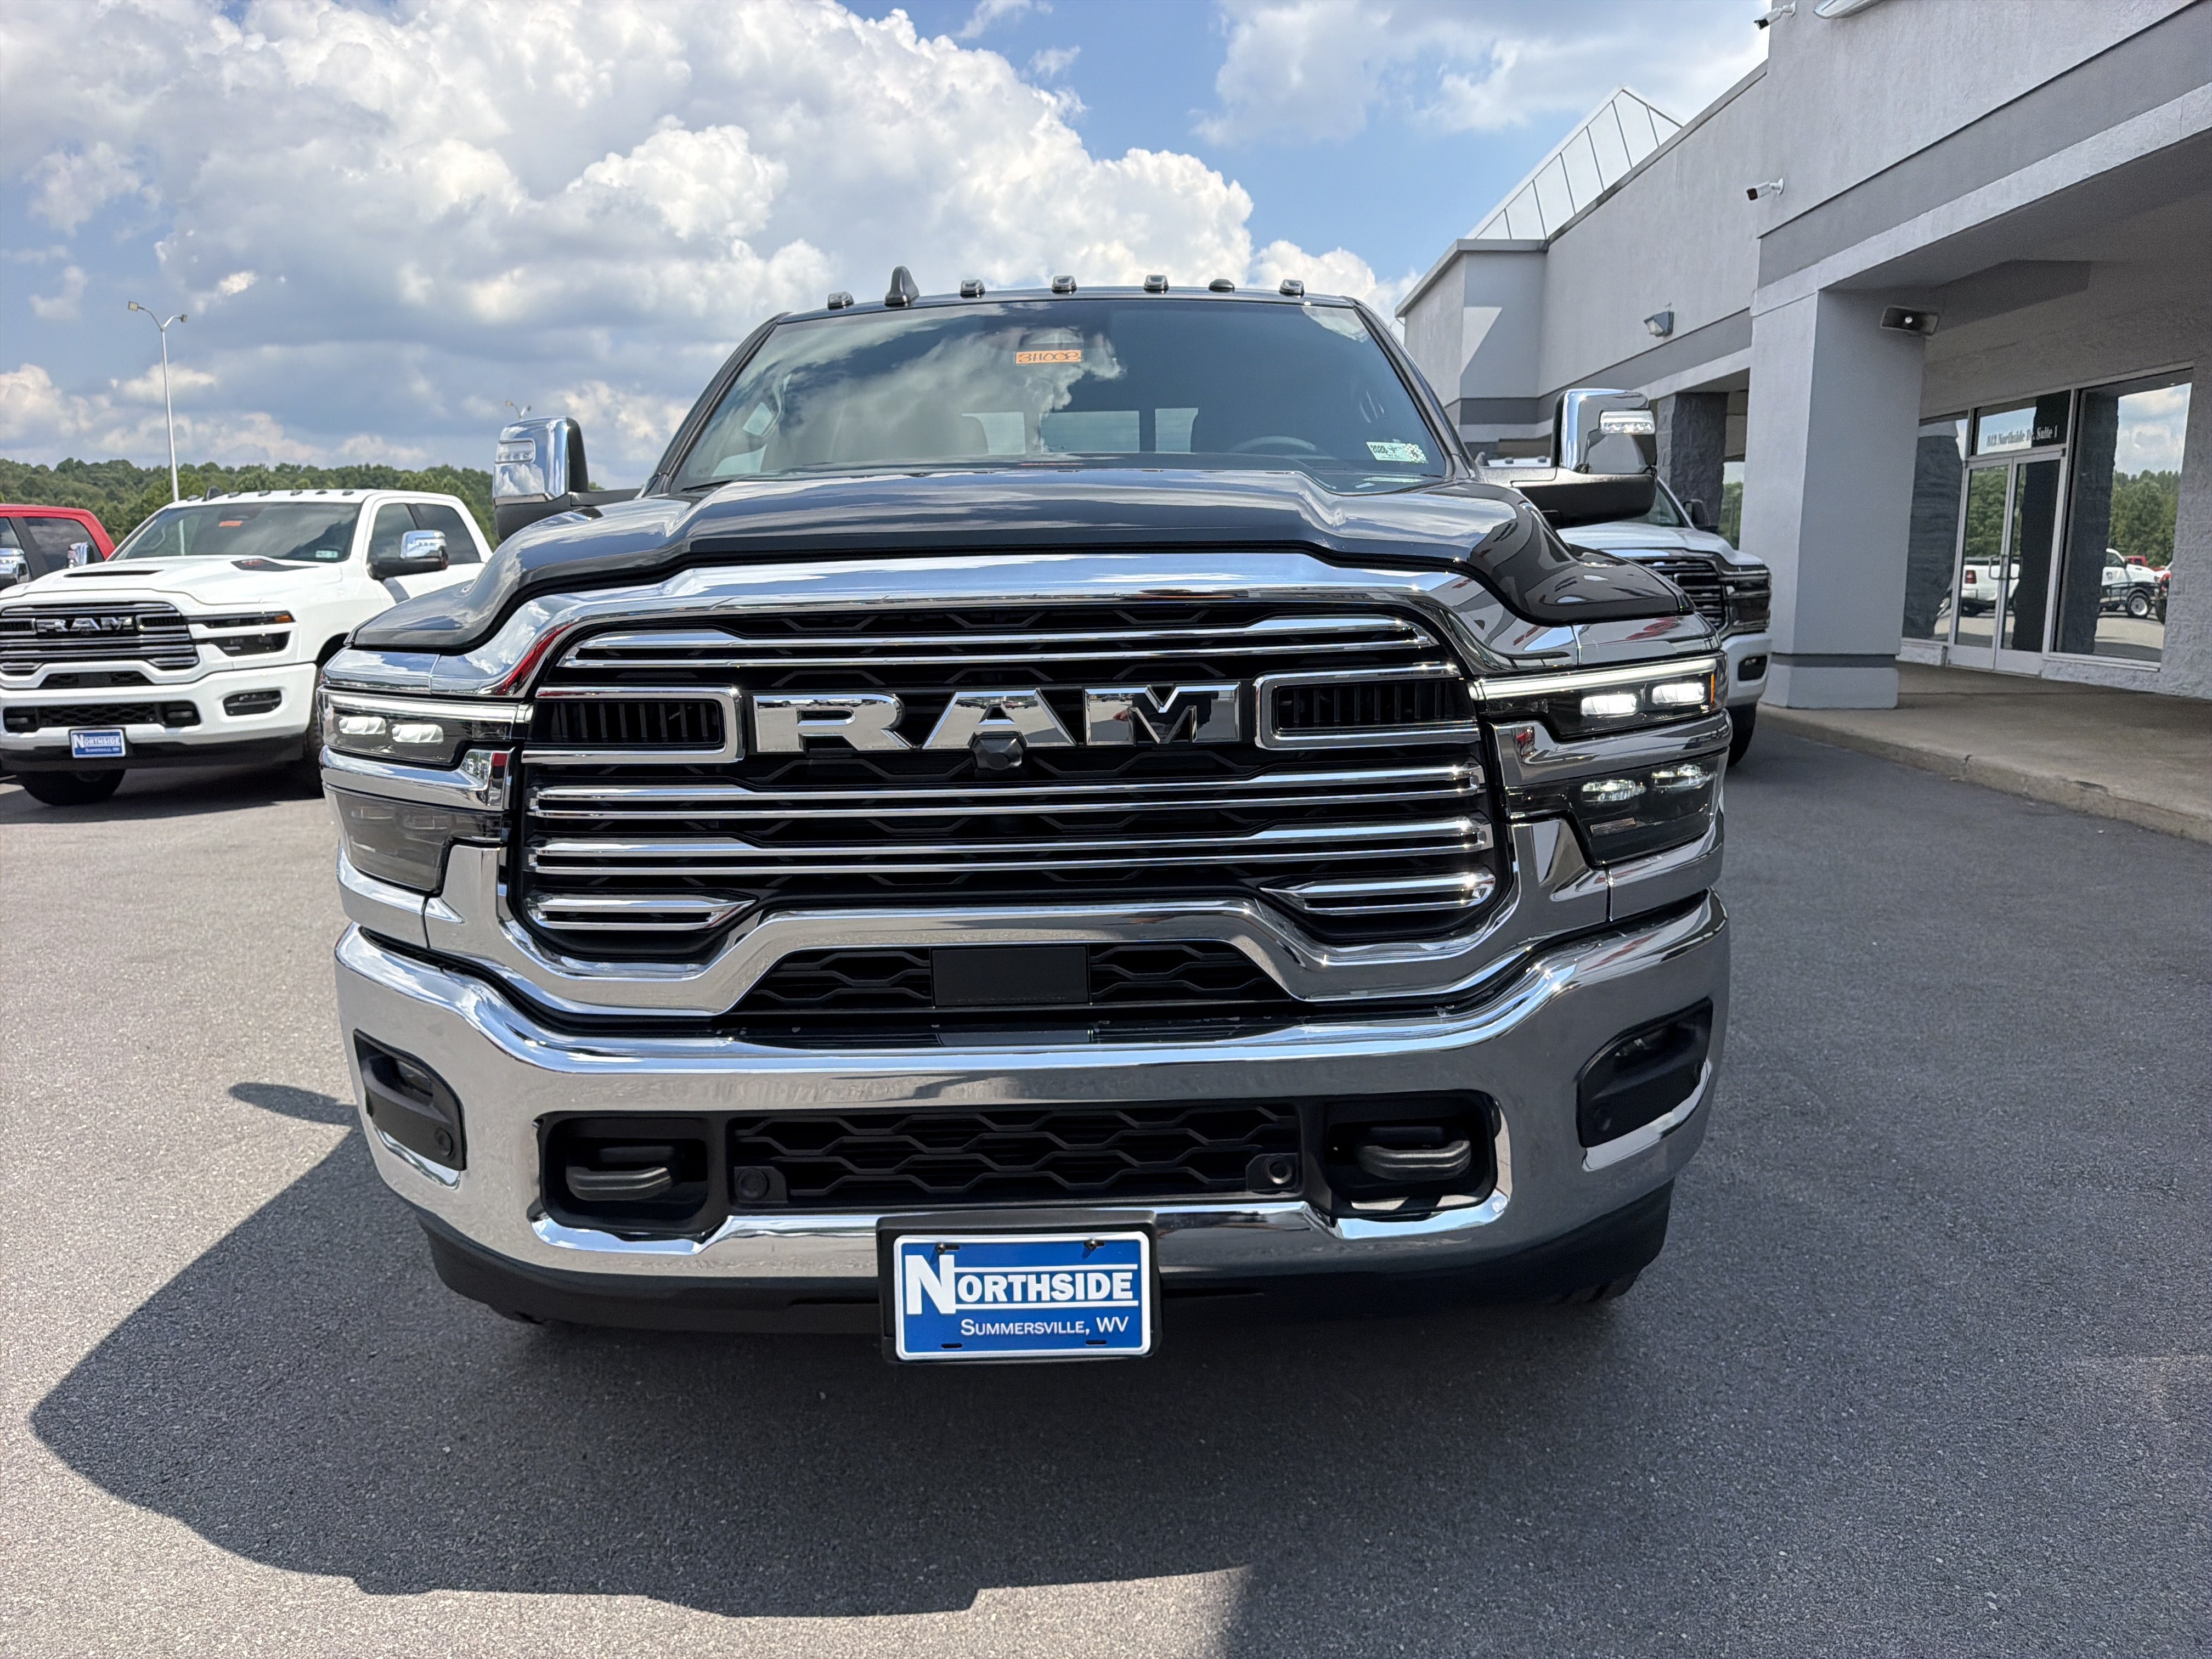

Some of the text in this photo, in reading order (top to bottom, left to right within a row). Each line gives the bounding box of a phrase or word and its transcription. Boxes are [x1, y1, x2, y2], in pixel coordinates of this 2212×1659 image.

[2036, 426, 2053, 440] Suite
[36, 616, 135, 631] RAM
[752, 683, 1241, 753] RAM
[73, 734, 120, 748] NORTHSIDE
[905, 1254, 1134, 1315] NORTHSIDE
[960, 1316, 1130, 1336] SUMMERSVILLE, WV
